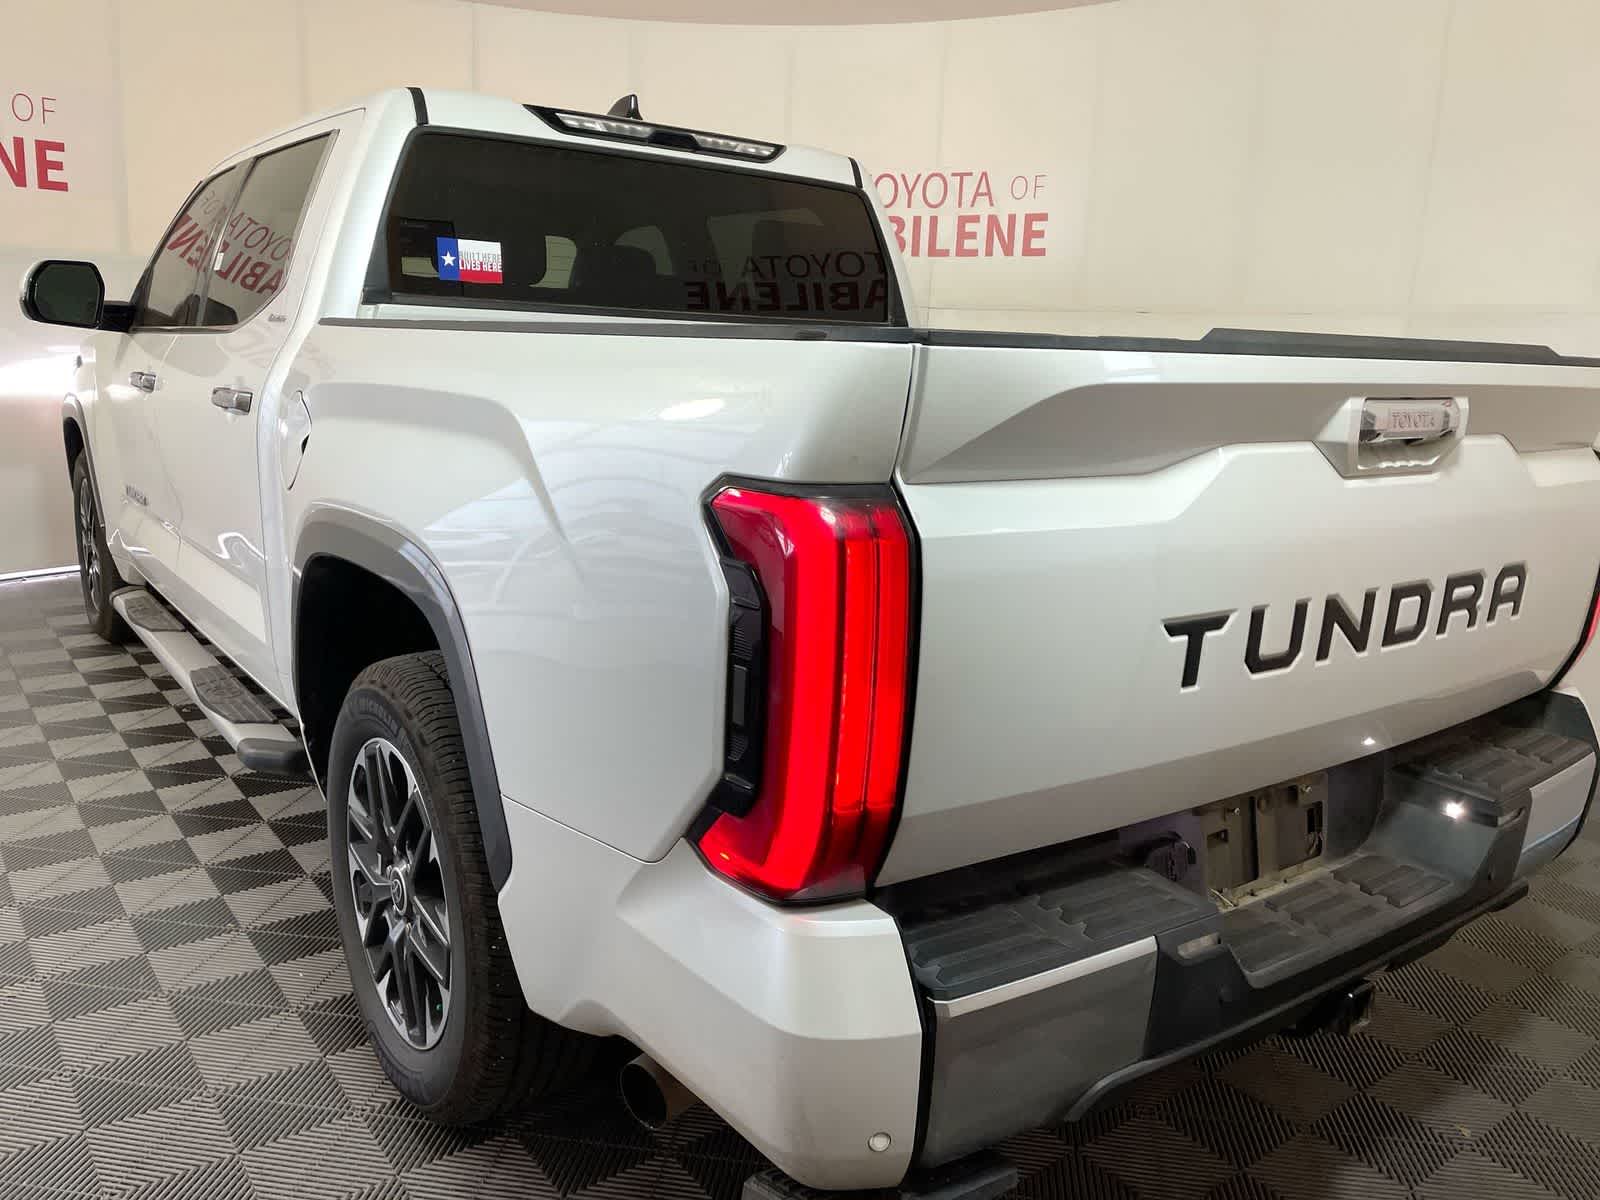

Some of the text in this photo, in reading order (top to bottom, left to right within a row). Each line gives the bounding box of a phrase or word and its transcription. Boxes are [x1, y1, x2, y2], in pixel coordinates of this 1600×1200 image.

[11, 92, 57, 125] OF
[871, 170, 1048, 209] OYOTA OF
[888, 212, 1049, 258] BILENE
[459, 258, 503, 273] LIVES HERE
[1161, 560, 1528, 692] TUNDRA
